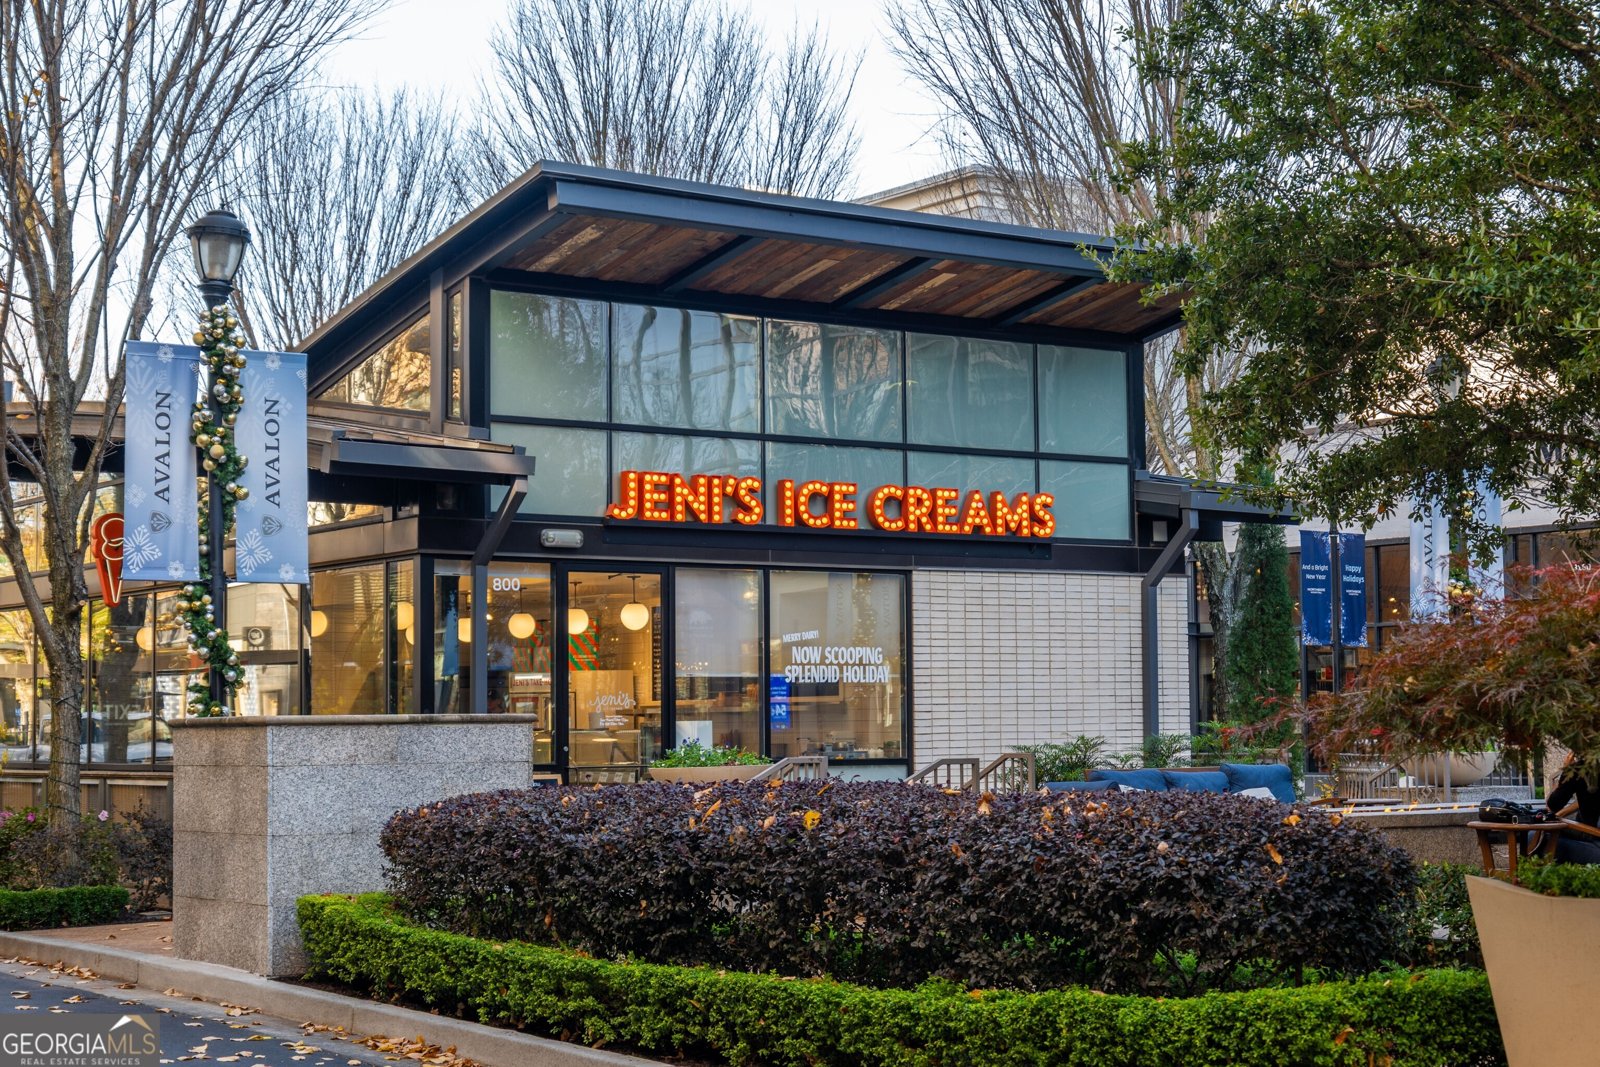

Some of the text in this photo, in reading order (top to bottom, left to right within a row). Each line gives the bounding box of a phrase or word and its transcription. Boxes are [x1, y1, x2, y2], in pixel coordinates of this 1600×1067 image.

[154, 389, 172, 505] AVALON
[264, 397, 281, 509] AVALON
[605, 470, 1056, 538] JENI'S ICE CREAMS
[1423, 507, 1433, 569] AVALO
[1345, 565, 1361, 573] Happy
[492, 577, 521, 592] 800
[1343, 575, 1364, 584] Holidays
[782, 629, 819, 643] MERRY DAIRY!
[792, 646, 883, 664] NOW SCOOPING
[785, 665, 890, 684] SPLENDID HOLIDAY
[588, 690, 637, 713] jeni's
